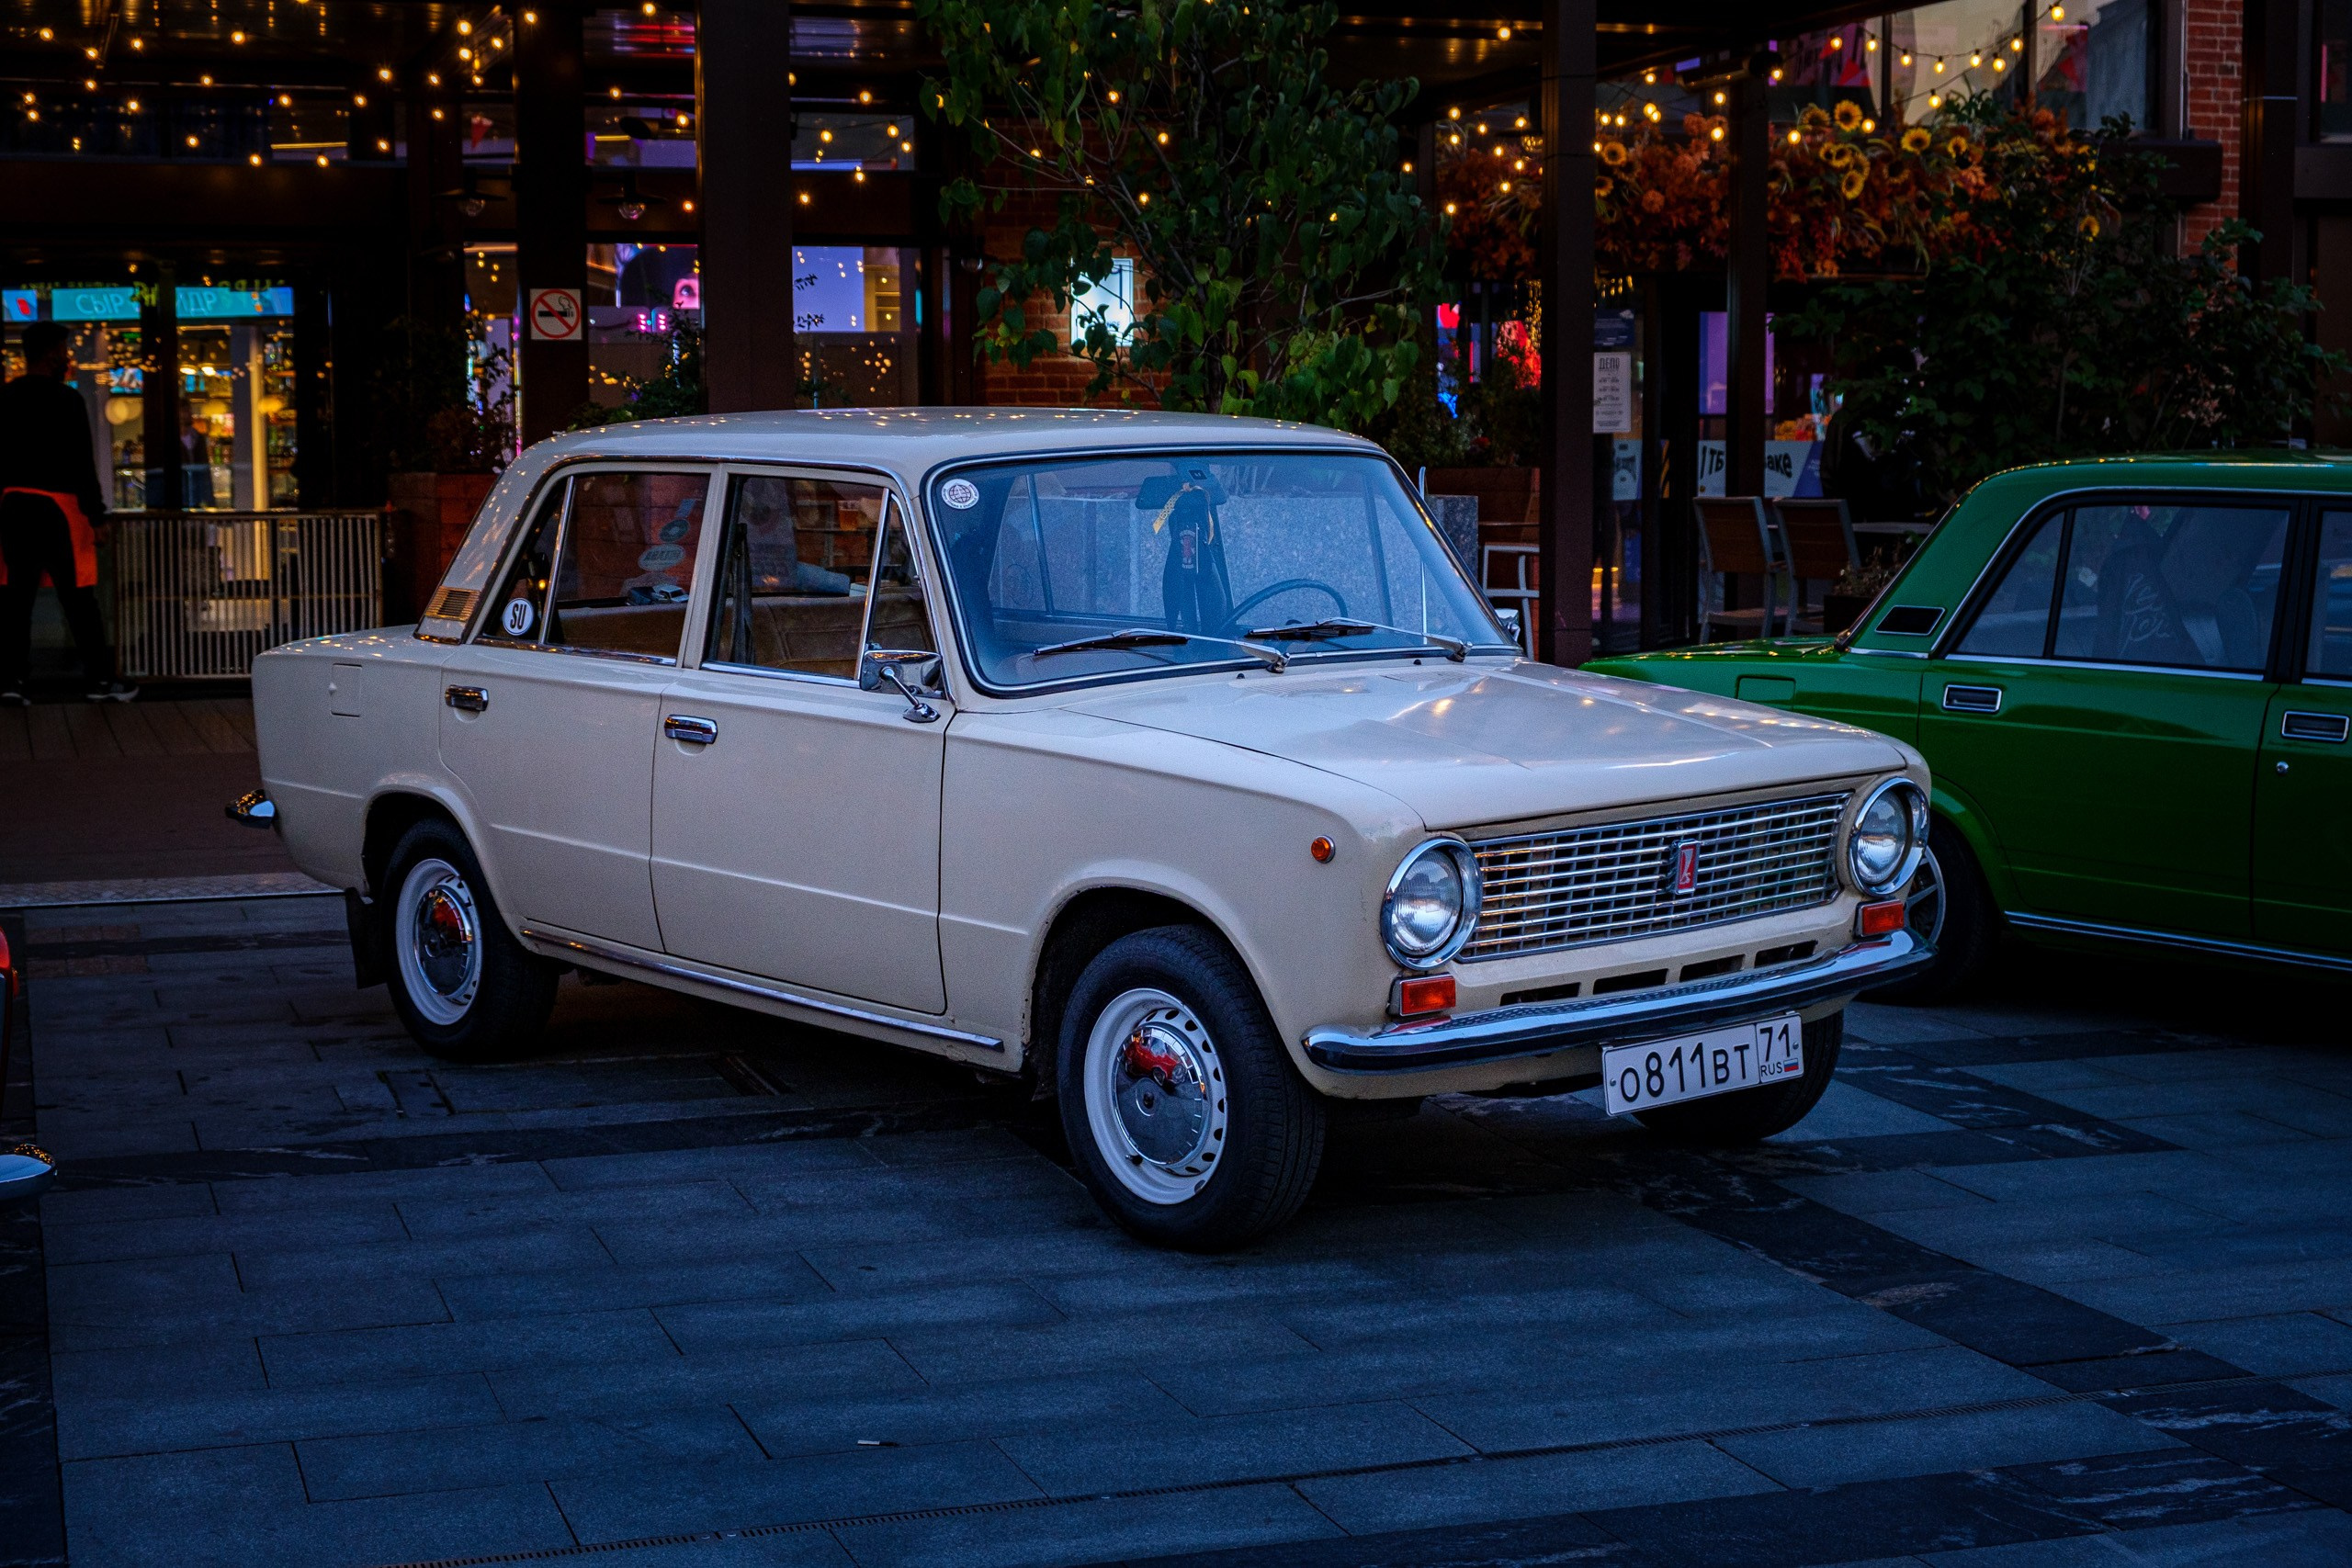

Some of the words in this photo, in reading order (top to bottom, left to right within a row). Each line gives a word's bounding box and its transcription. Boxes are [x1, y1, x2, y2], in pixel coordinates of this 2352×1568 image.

[1764, 453, 1792, 479] аке
[510, 603, 527, 630] SU
[1759, 1023, 1791, 1063] 71
[1760, 1061, 1783, 1077] RUS
